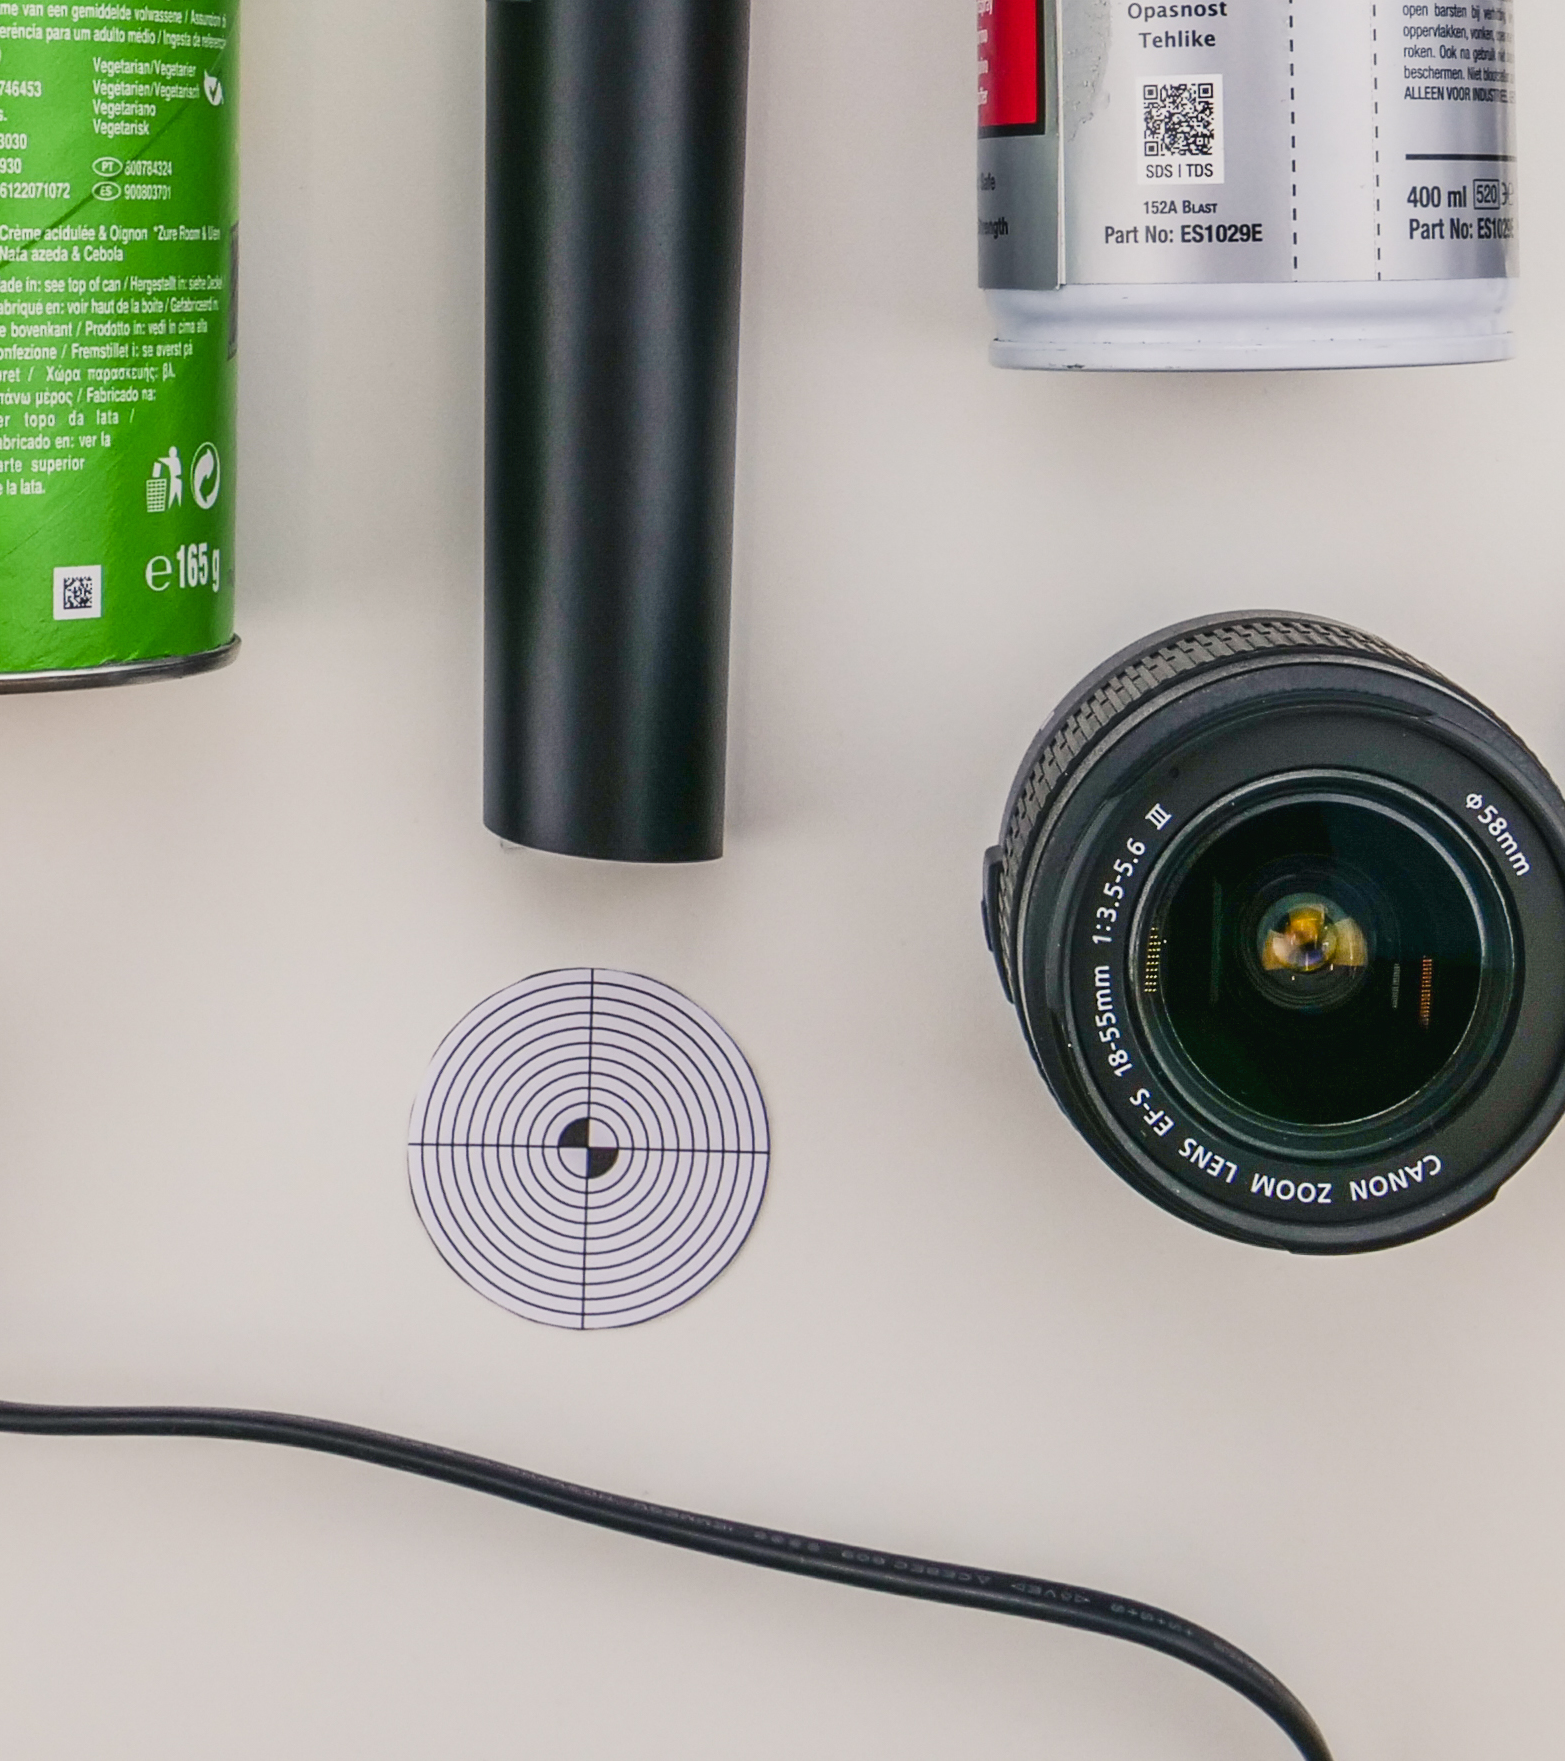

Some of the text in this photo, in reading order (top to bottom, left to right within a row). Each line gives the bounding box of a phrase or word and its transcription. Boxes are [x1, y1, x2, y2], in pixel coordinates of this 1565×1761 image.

[1127, 1, 1228, 23] Opasnost
[1138, 30, 1217, 49] Tehlike
[1146, 163, 1214, 179] SDS TDS
[1143, 200, 1178, 215] 152A
[1406, 183, 1498, 208] 400 ml 520
[1104, 223, 1264, 245] Part No: ES1029E
[1409, 217, 1474, 240] Part No:
[31, 246, 69, 262] azeda
[71, 245, 81, 261] &
[83, 245, 124, 262] Cebola
[31, 457, 86, 476] superior
[176, 542, 209, 589] 165
[211, 548, 221, 593] g
[1091, 837, 1146, 946] 1:3.5-5.6
[1094, 964, 1135, 1078] 18-55mm
[1128, 1085, 1175, 1139] EF-S
[1178, 1136, 1240, 1184] LENS
[1249, 1171, 1333, 1205] ZOOM
[1348, 1153, 1444, 1203] CANON
